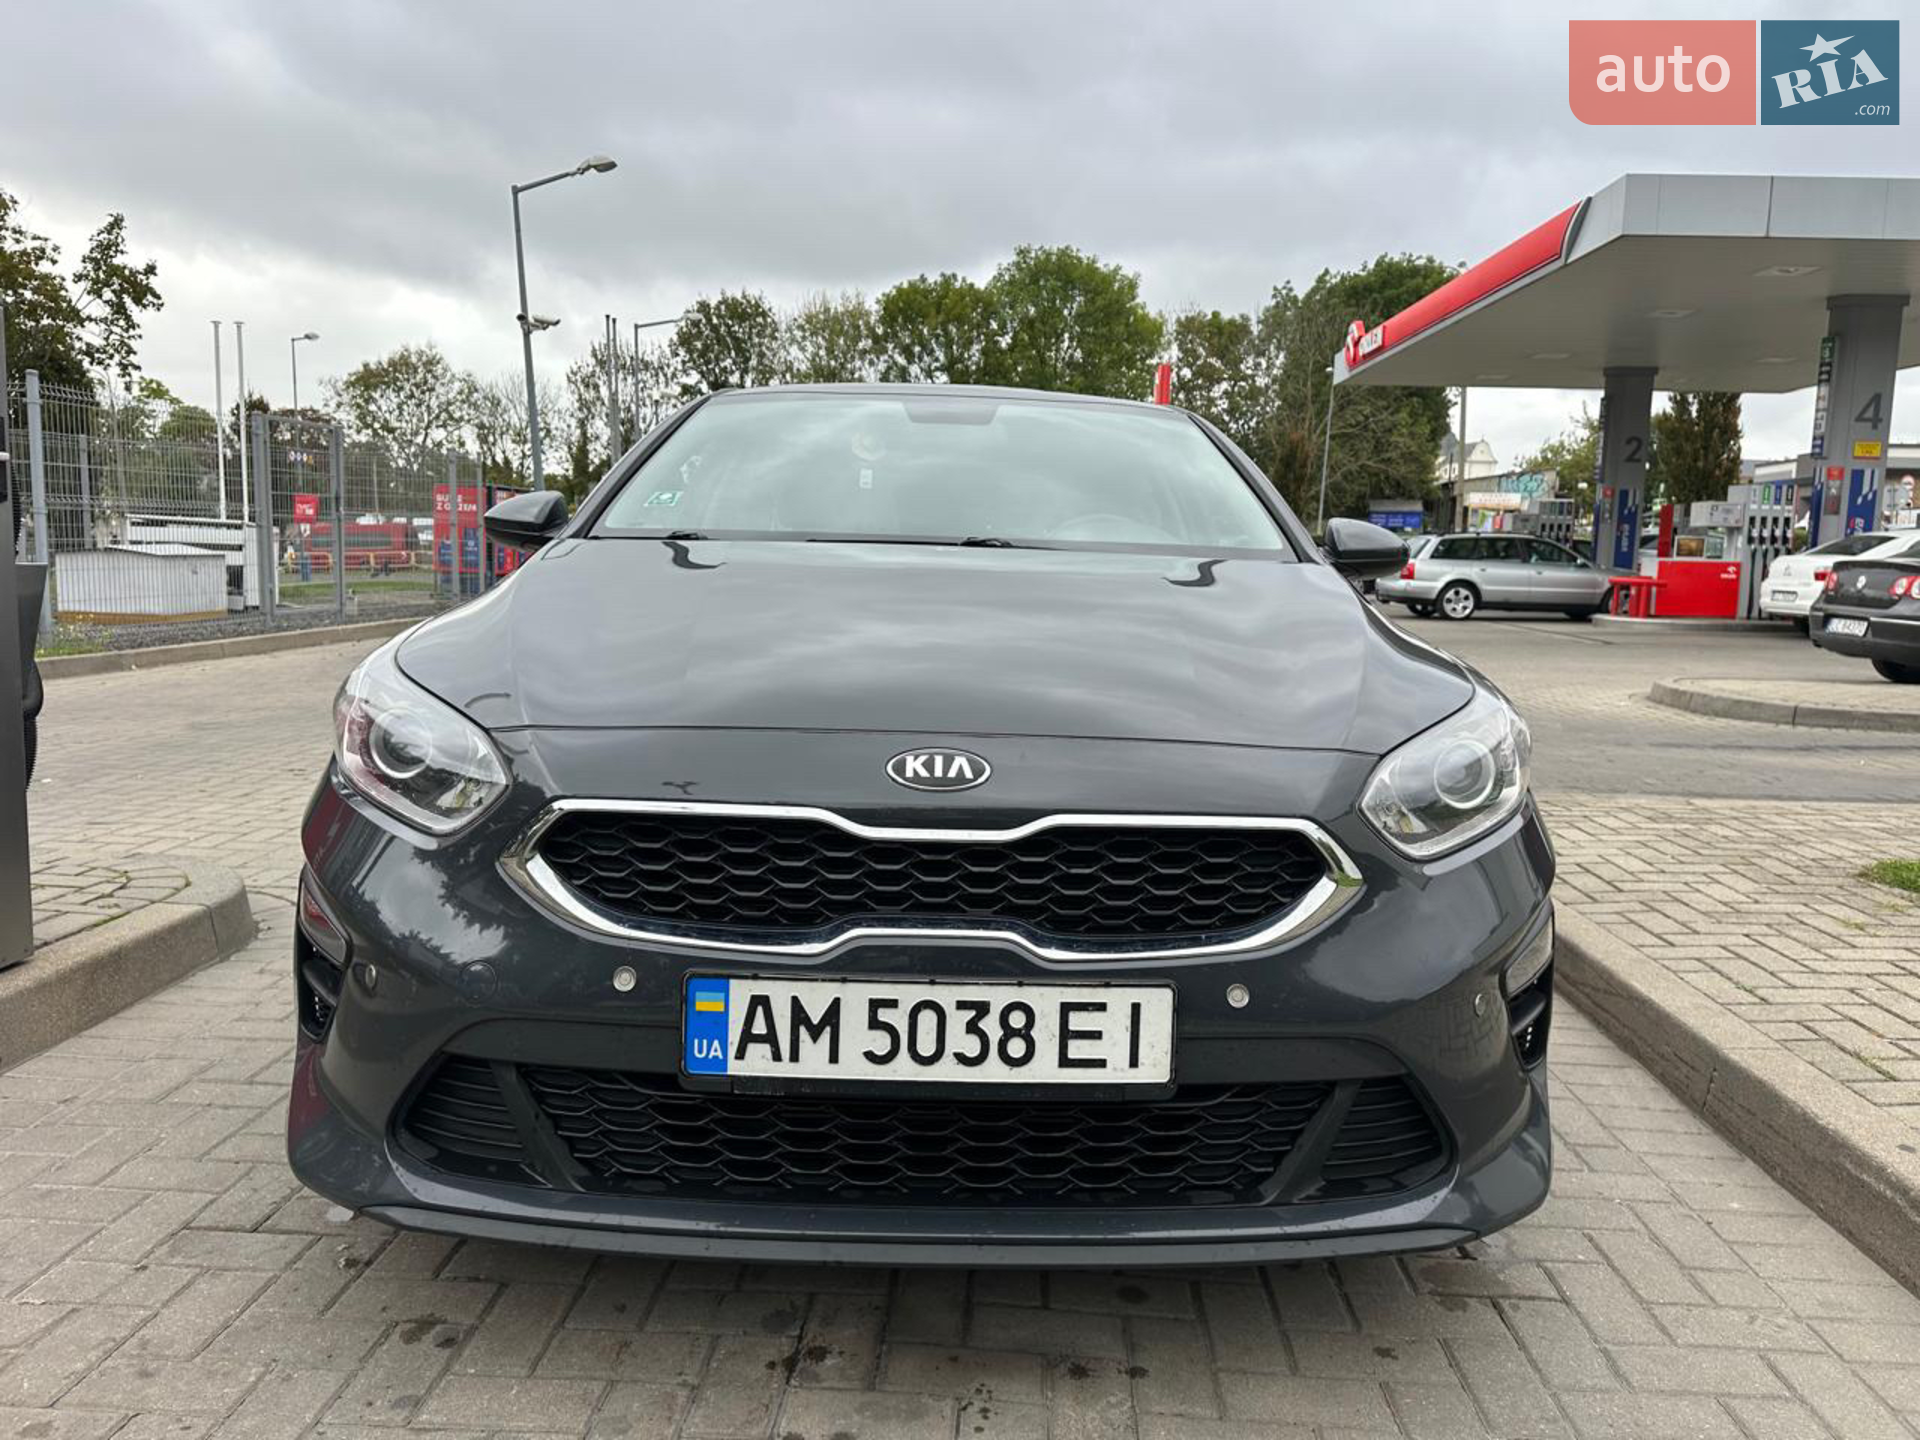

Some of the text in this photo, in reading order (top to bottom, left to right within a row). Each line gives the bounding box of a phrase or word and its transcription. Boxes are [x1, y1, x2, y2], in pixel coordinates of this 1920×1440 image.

[1854, 393, 1883, 430] 4
[1624, 436, 1643, 463] 2
[905, 754, 974, 779] KIA
[733, 994, 1142, 1069] AM 5038 EI
[694, 1038, 724, 1060] UA
